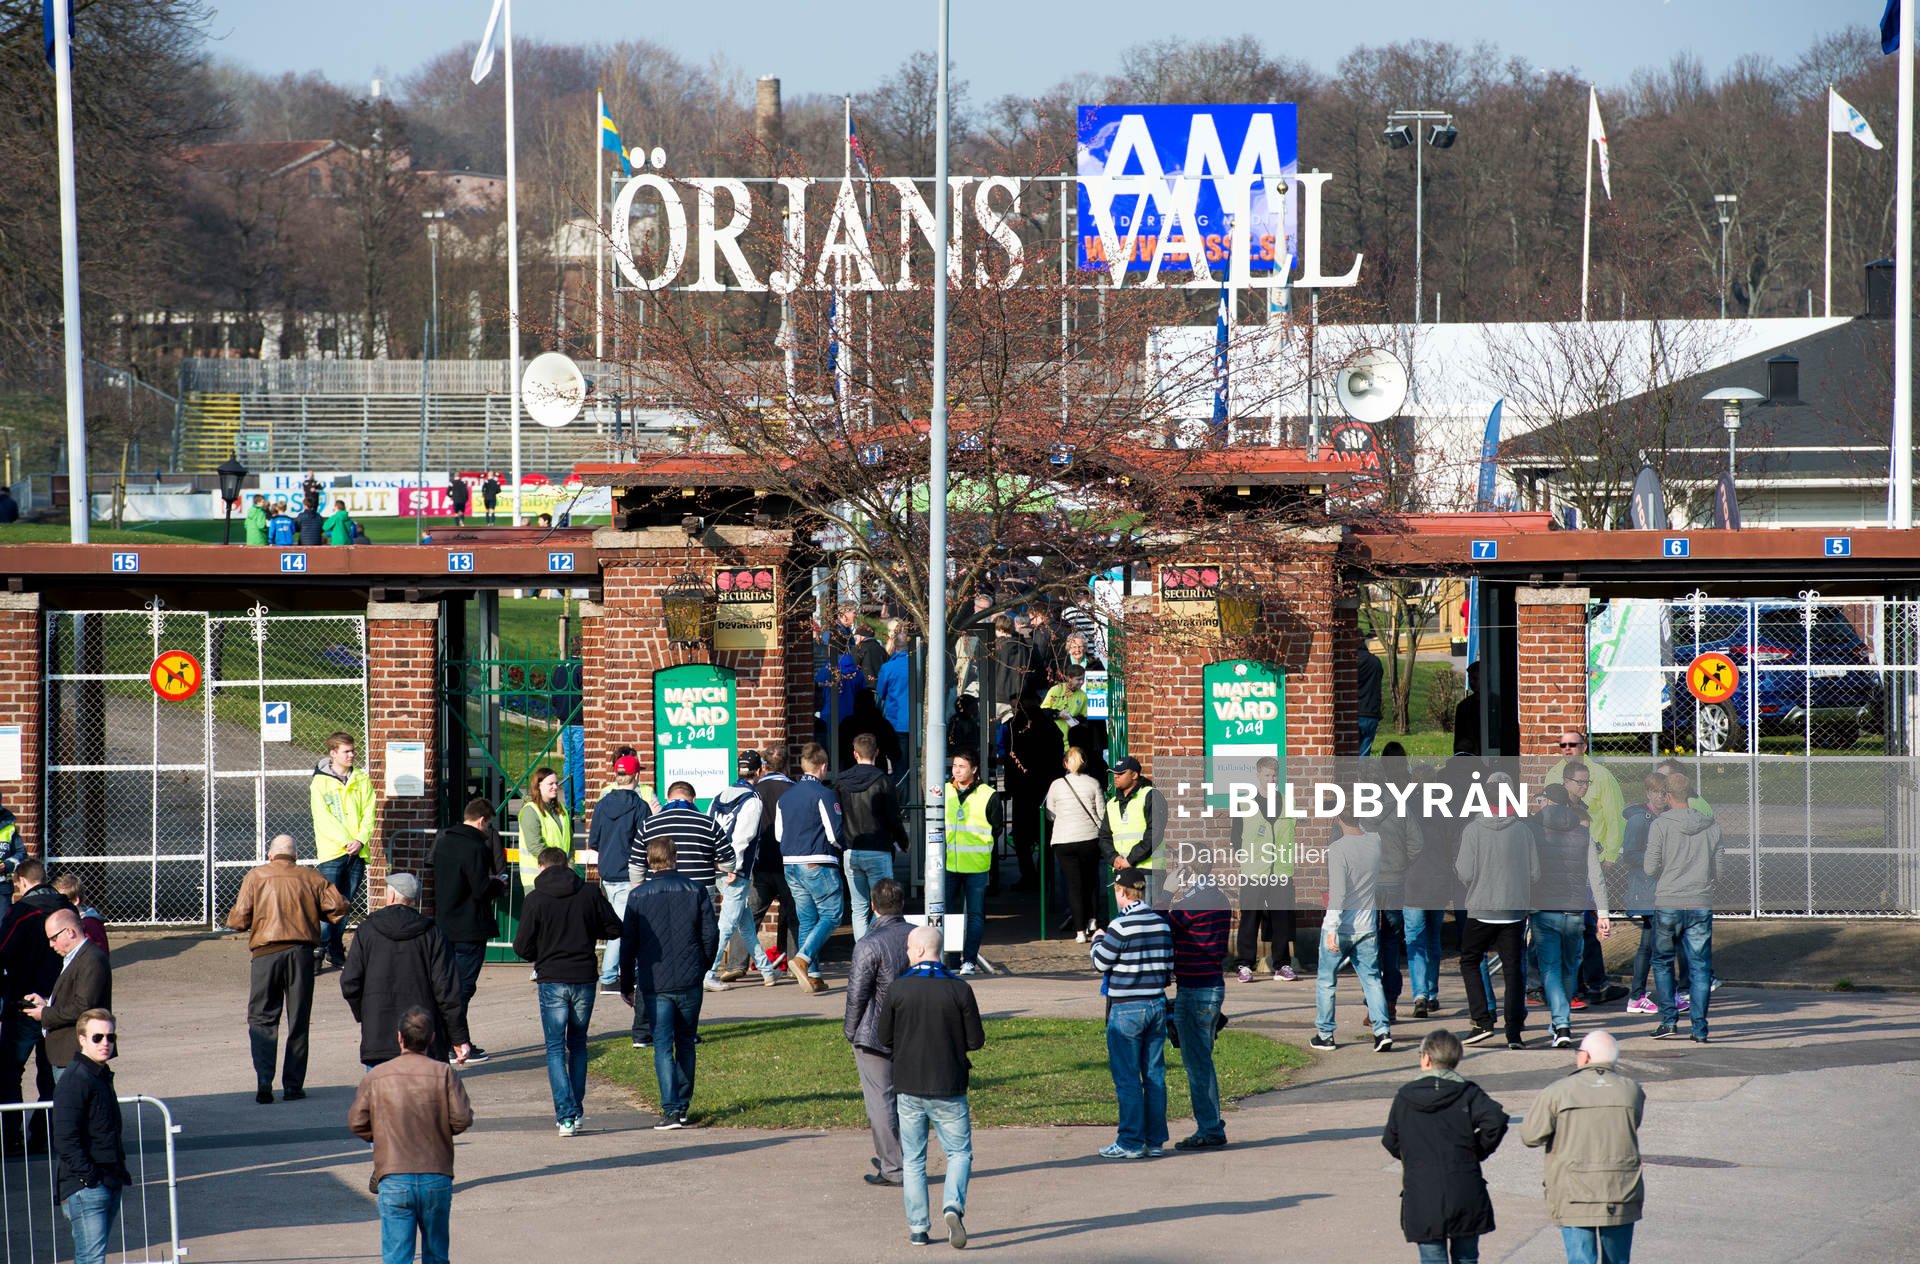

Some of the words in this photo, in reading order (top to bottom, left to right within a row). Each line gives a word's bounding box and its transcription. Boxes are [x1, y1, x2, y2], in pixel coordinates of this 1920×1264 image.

[611, 146, 1025, 294] ÖRJANS
[1076, 172, 1364, 290] VALL
[274, 473, 430, 488] Hsposten
[1480, 543, 1489, 557] 7
[1671, 541, 1681, 555] 6
[1833, 540, 1843, 554] 5
[115, 555, 135, 570] 15
[284, 555, 304, 570] 14
[451, 555, 470, 570] 13
[552, 555, 571, 570] 12
[717, 591, 773, 602] SECURITAS
[664, 687, 728, 704] MATCH
[1213, 681, 1277, 698] MATCH
